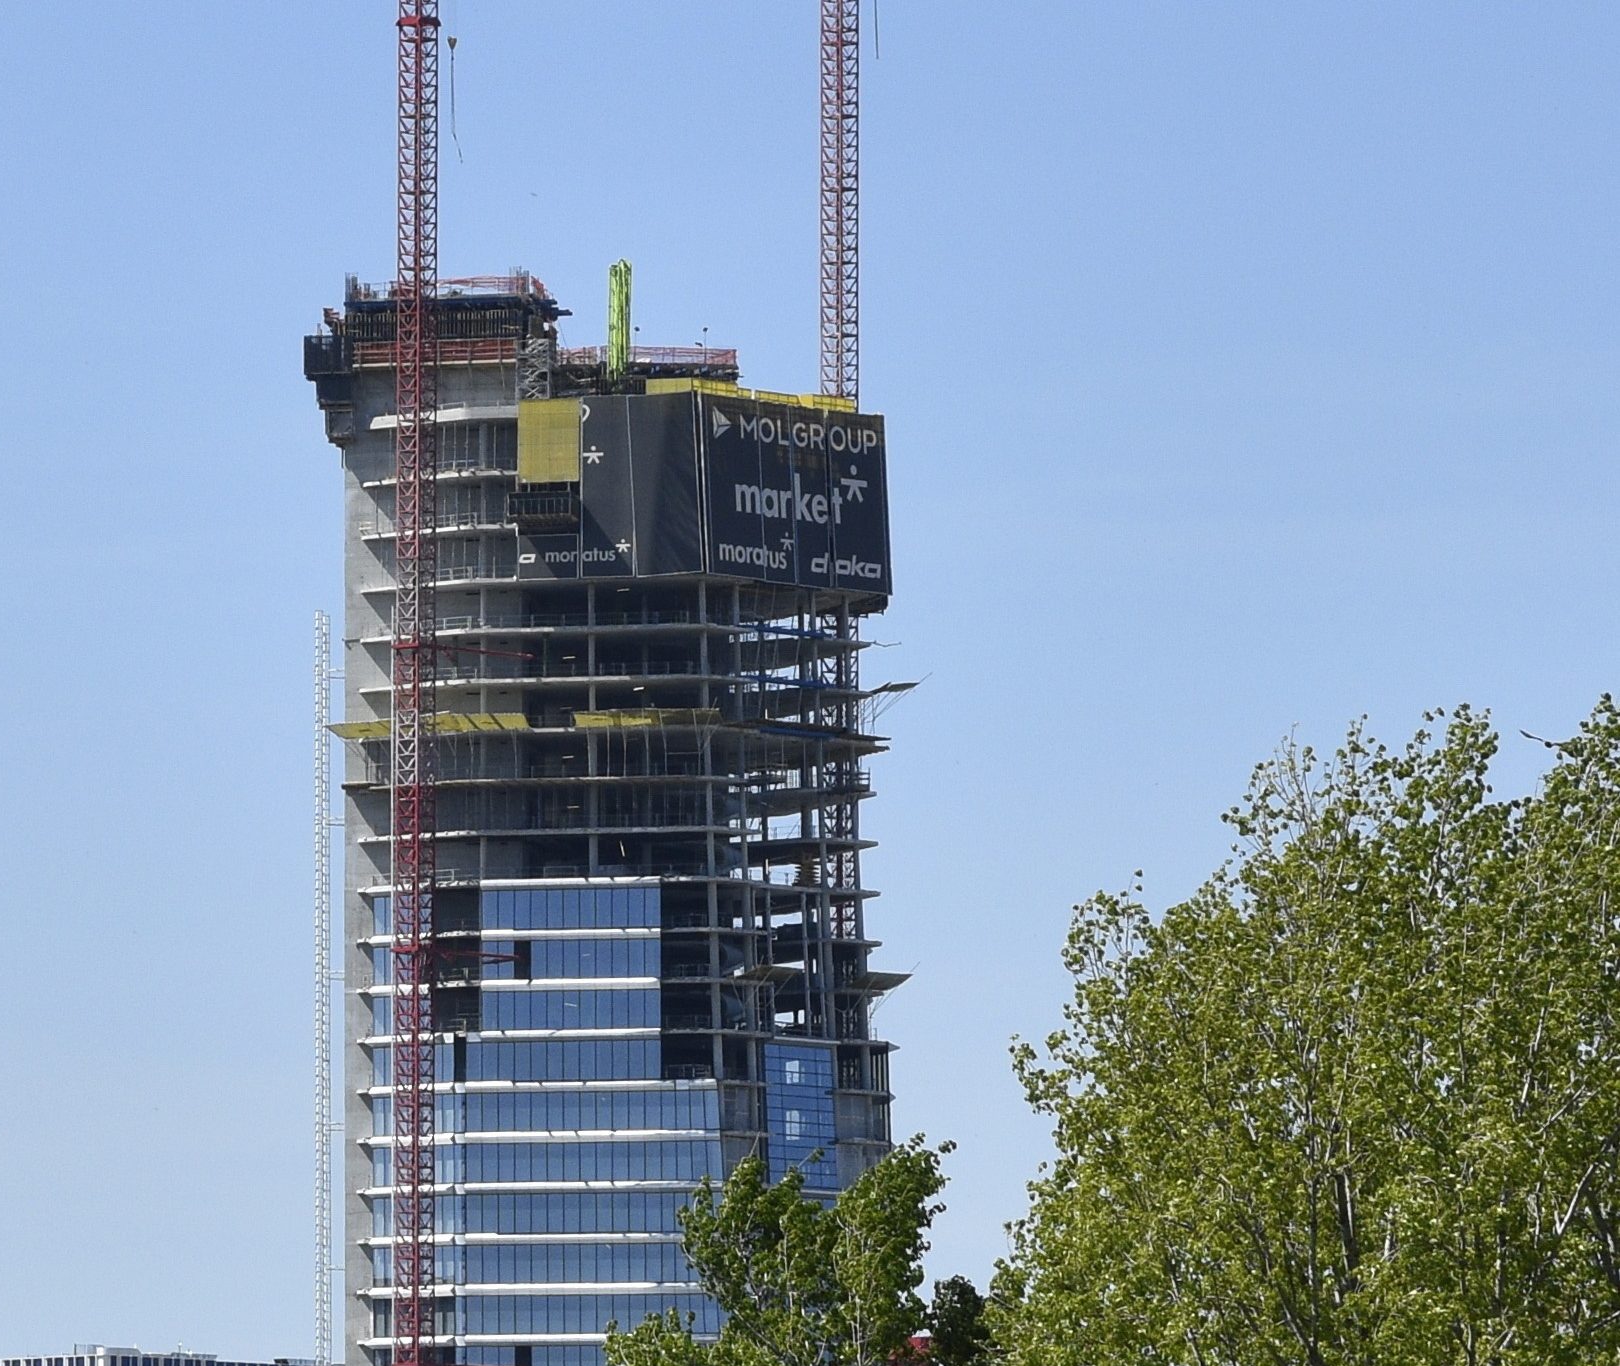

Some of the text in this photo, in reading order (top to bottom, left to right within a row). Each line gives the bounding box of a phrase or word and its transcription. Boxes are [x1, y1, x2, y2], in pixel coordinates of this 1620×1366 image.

[735, 473, 843, 524] market
[545, 547, 616, 562] moratus
[719, 542, 787, 569] moratus
[811, 552, 881, 578] doka
